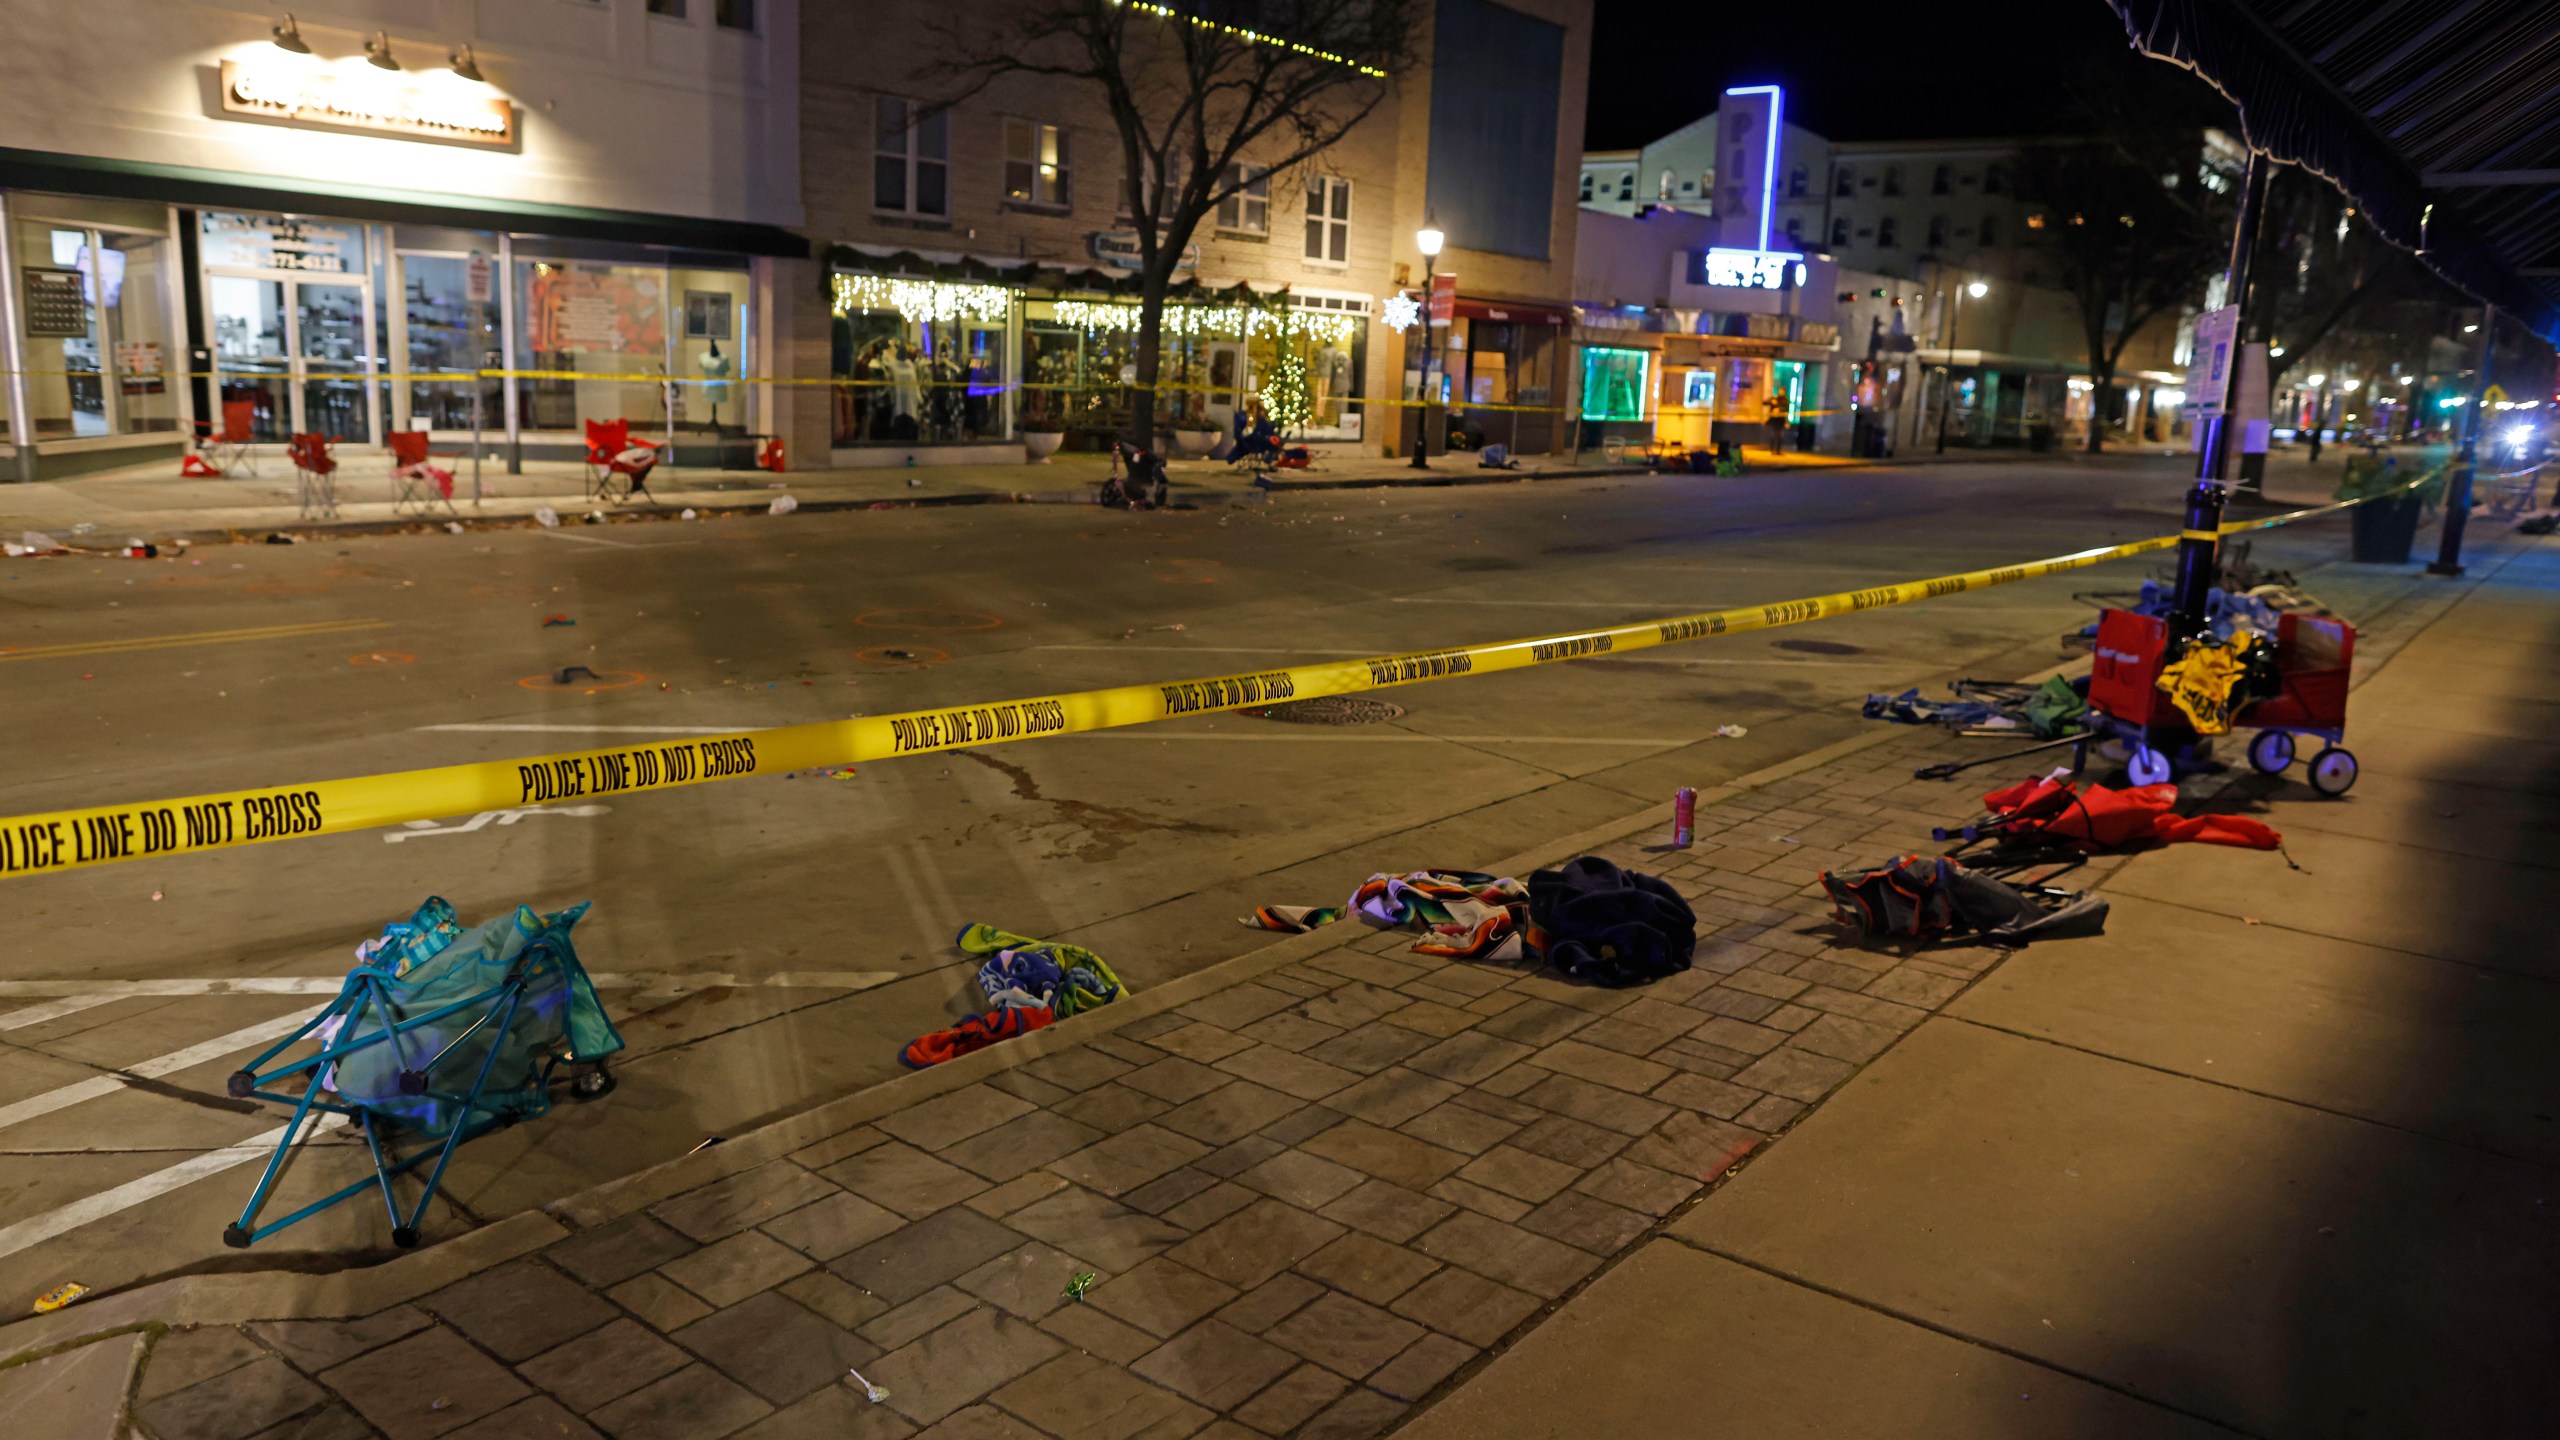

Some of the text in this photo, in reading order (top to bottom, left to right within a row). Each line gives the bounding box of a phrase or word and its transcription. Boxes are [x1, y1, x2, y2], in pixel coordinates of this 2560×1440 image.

[1160, 672, 1294, 714] POLICE LINE DO NOT CROSS
[1366, 649, 1472, 685] POLICE LINE DO NOT CROSS
[890, 700, 1064, 752] POLICE LINE DO NOT CROSS
[518, 738, 756, 803] POLICE LINE DO NOT CROSS
[0, 791, 322, 872] LICE LINE DO NOT CROSS
